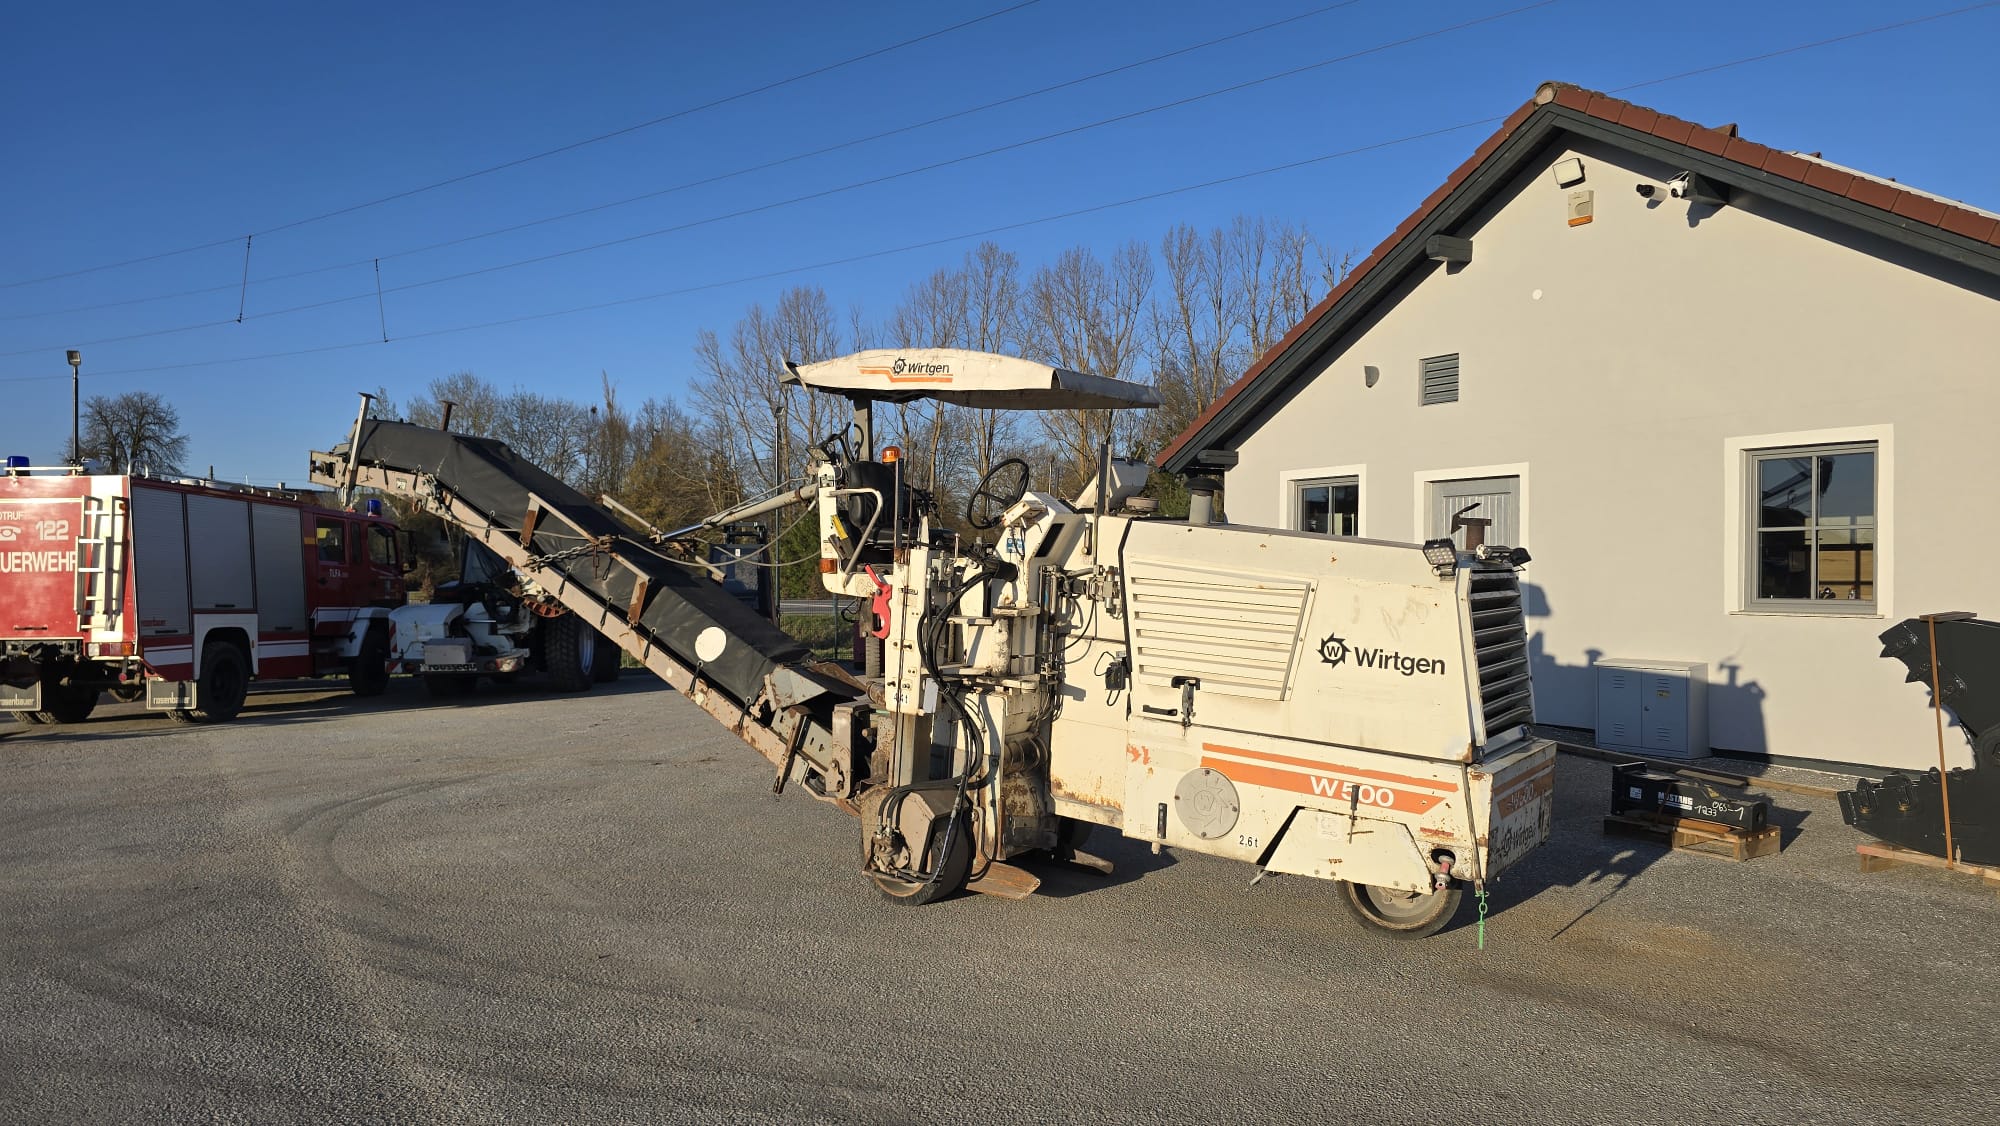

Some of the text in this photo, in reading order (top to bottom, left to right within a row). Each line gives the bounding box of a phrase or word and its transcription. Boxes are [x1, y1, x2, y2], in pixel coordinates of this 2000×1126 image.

[908, 362, 950, 376] Wirtgen
[35, 519, 69, 541] 122
[1353, 646, 1446, 677] Wirtgen
[1310, 775, 1395, 807] W 500
[1657, 791, 1694, 806] MSTANG
